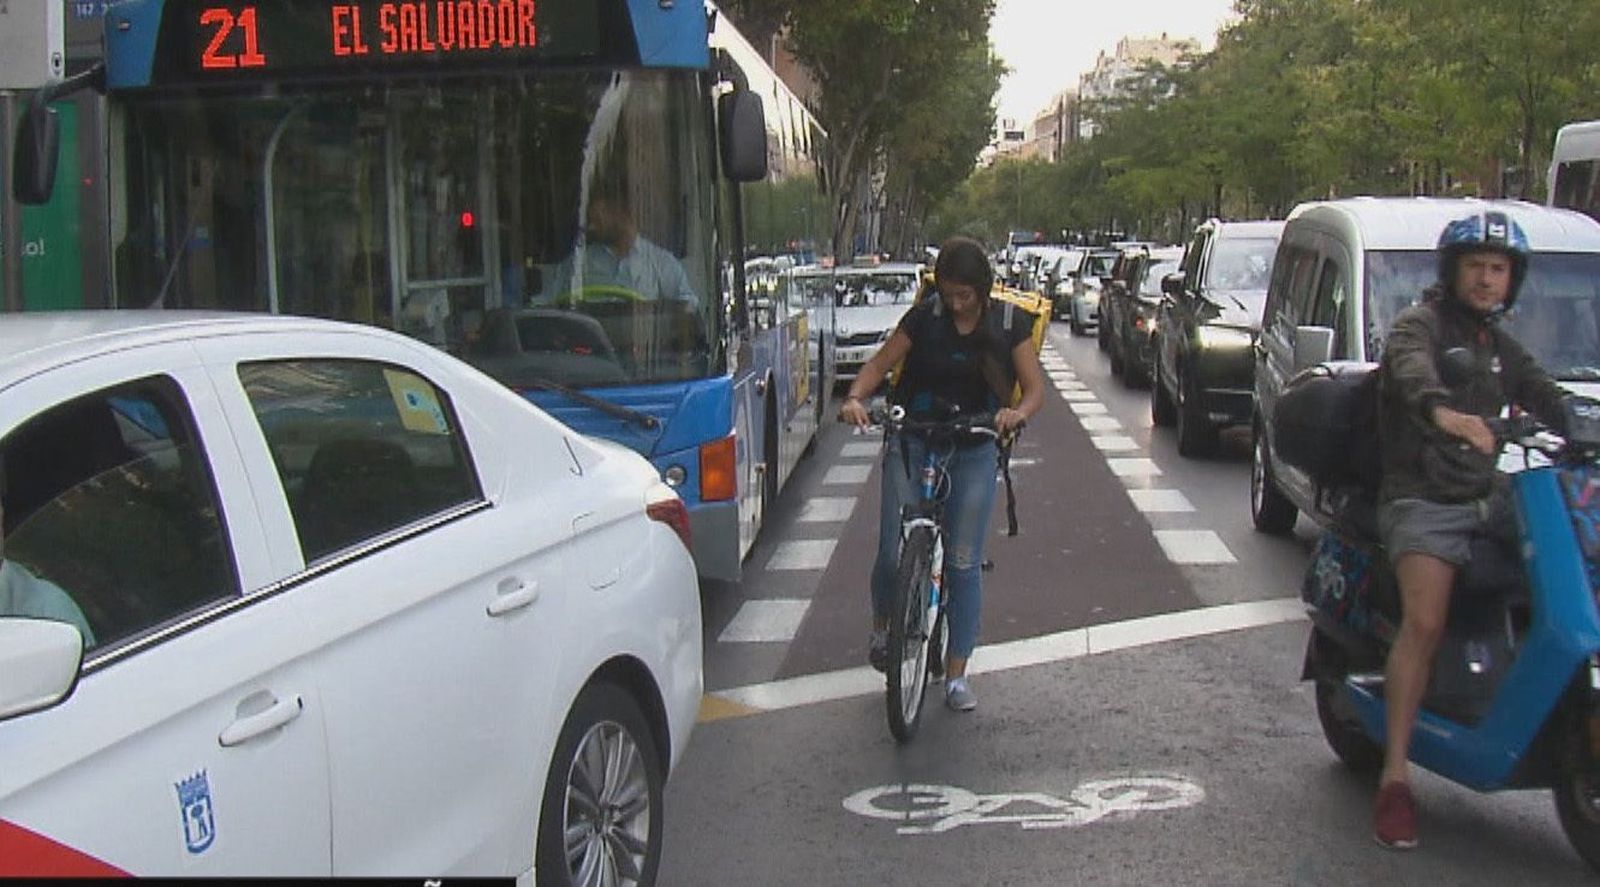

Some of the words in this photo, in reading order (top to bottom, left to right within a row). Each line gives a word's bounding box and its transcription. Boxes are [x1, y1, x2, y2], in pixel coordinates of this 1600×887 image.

[200, 7, 266, 68] 21
[332, 5, 369, 56] EL
[379, 0, 536, 54] SALVADOR
